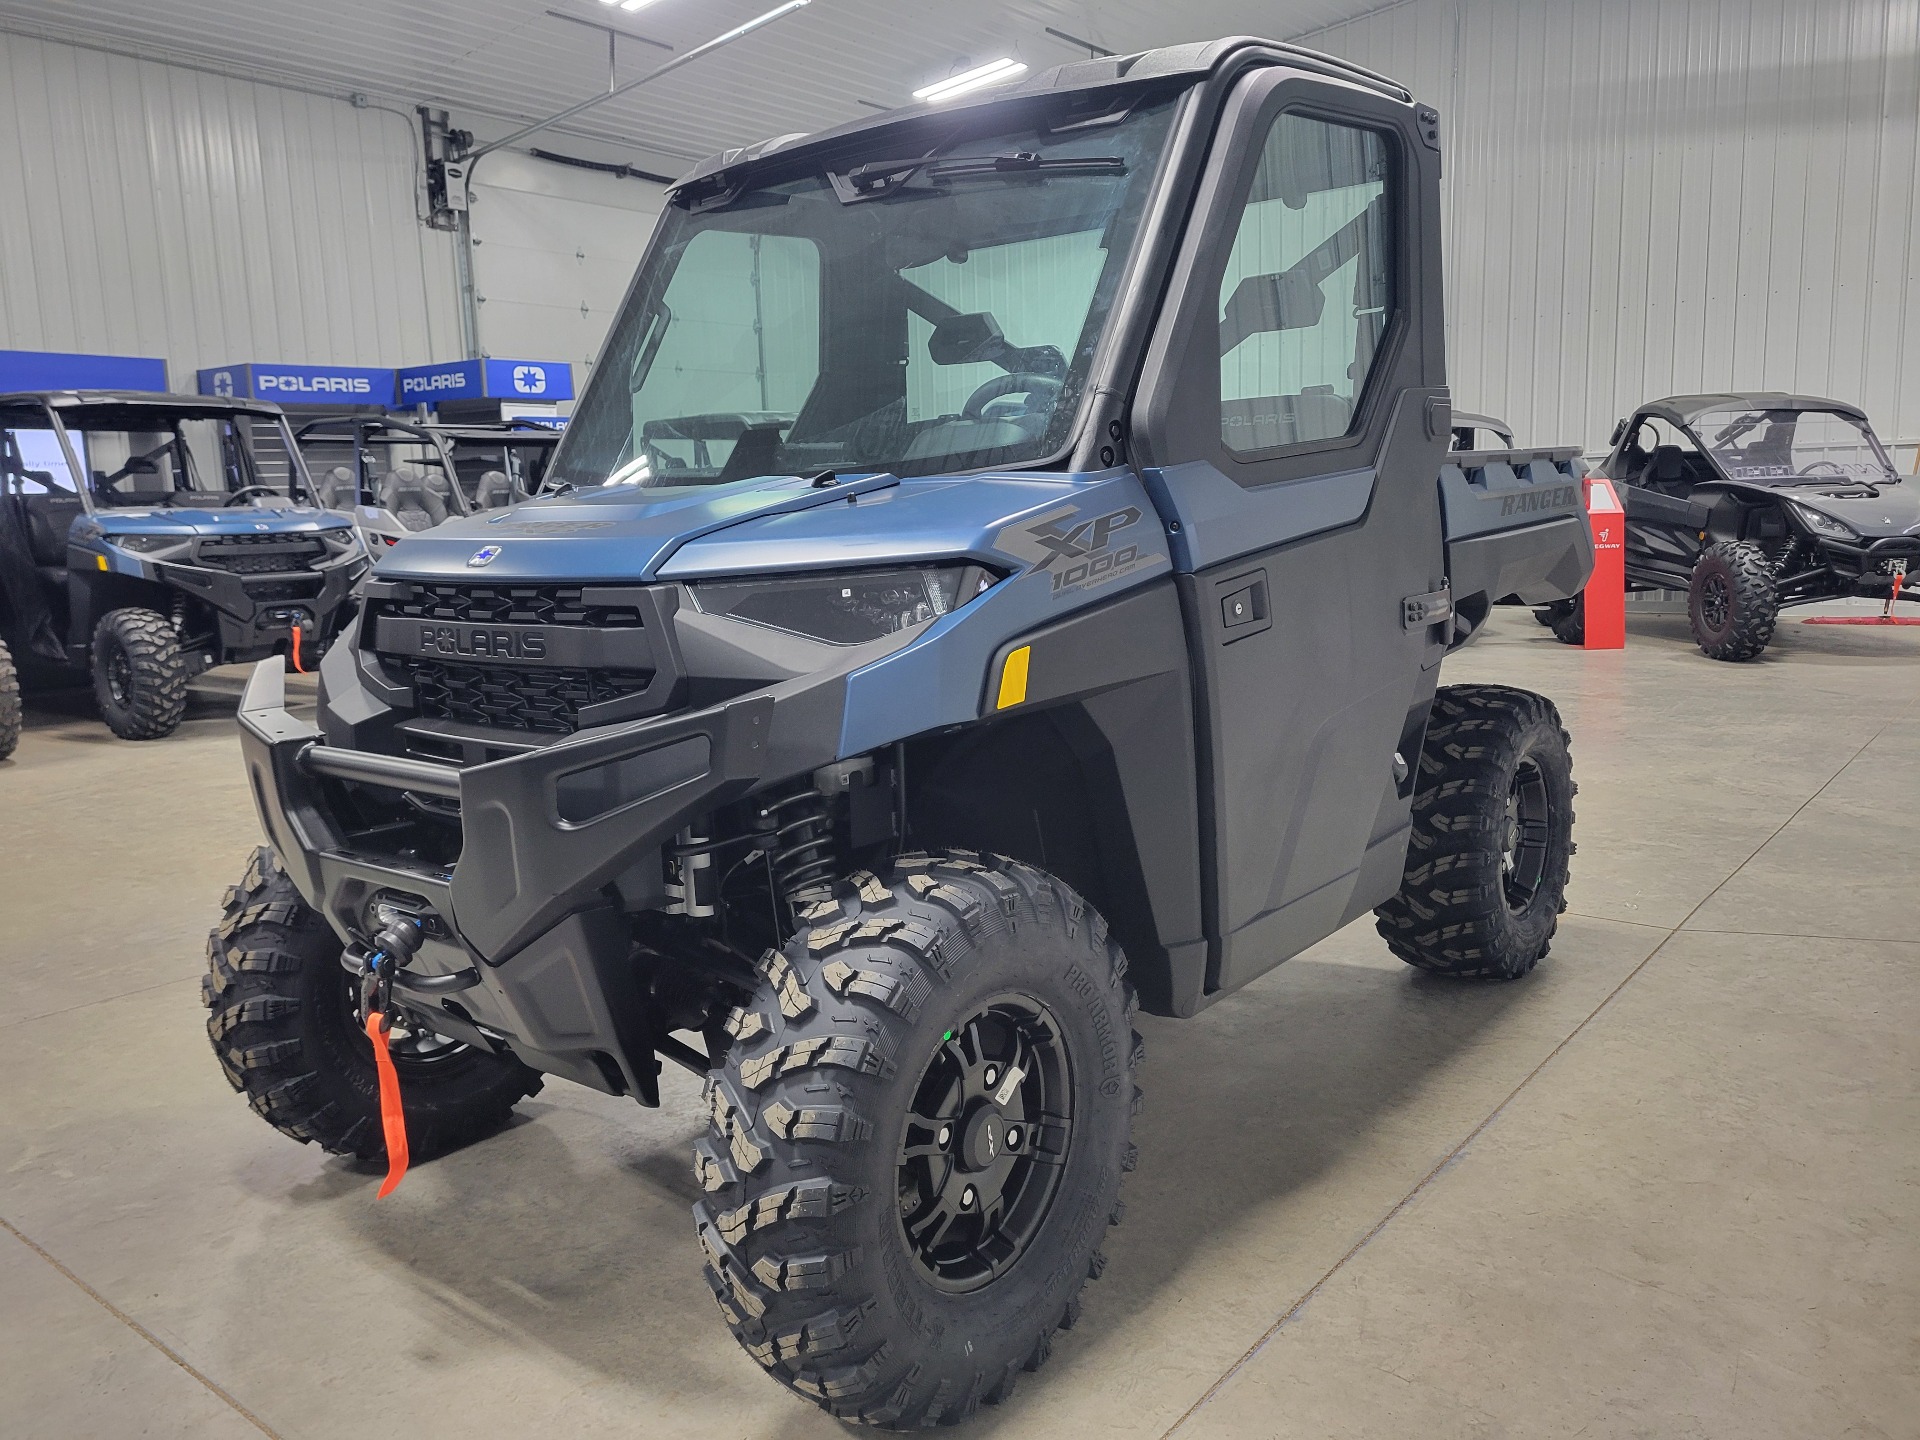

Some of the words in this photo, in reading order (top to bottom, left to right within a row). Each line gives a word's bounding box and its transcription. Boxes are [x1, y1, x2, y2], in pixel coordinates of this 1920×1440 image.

[258, 375, 371, 393] POLARIS
[403, 372, 466, 393] POLARIS
[1221, 413, 1296, 427] POLARIS
[1501, 486, 1578, 516] RANGER
[1025, 505, 1143, 576] XP
[1052, 545, 1138, 591] 1000
[420, 626, 546, 659] POLARIS
[1064, 964, 1094, 999] PRO
[1087, 998, 1118, 1075] ARMOR
